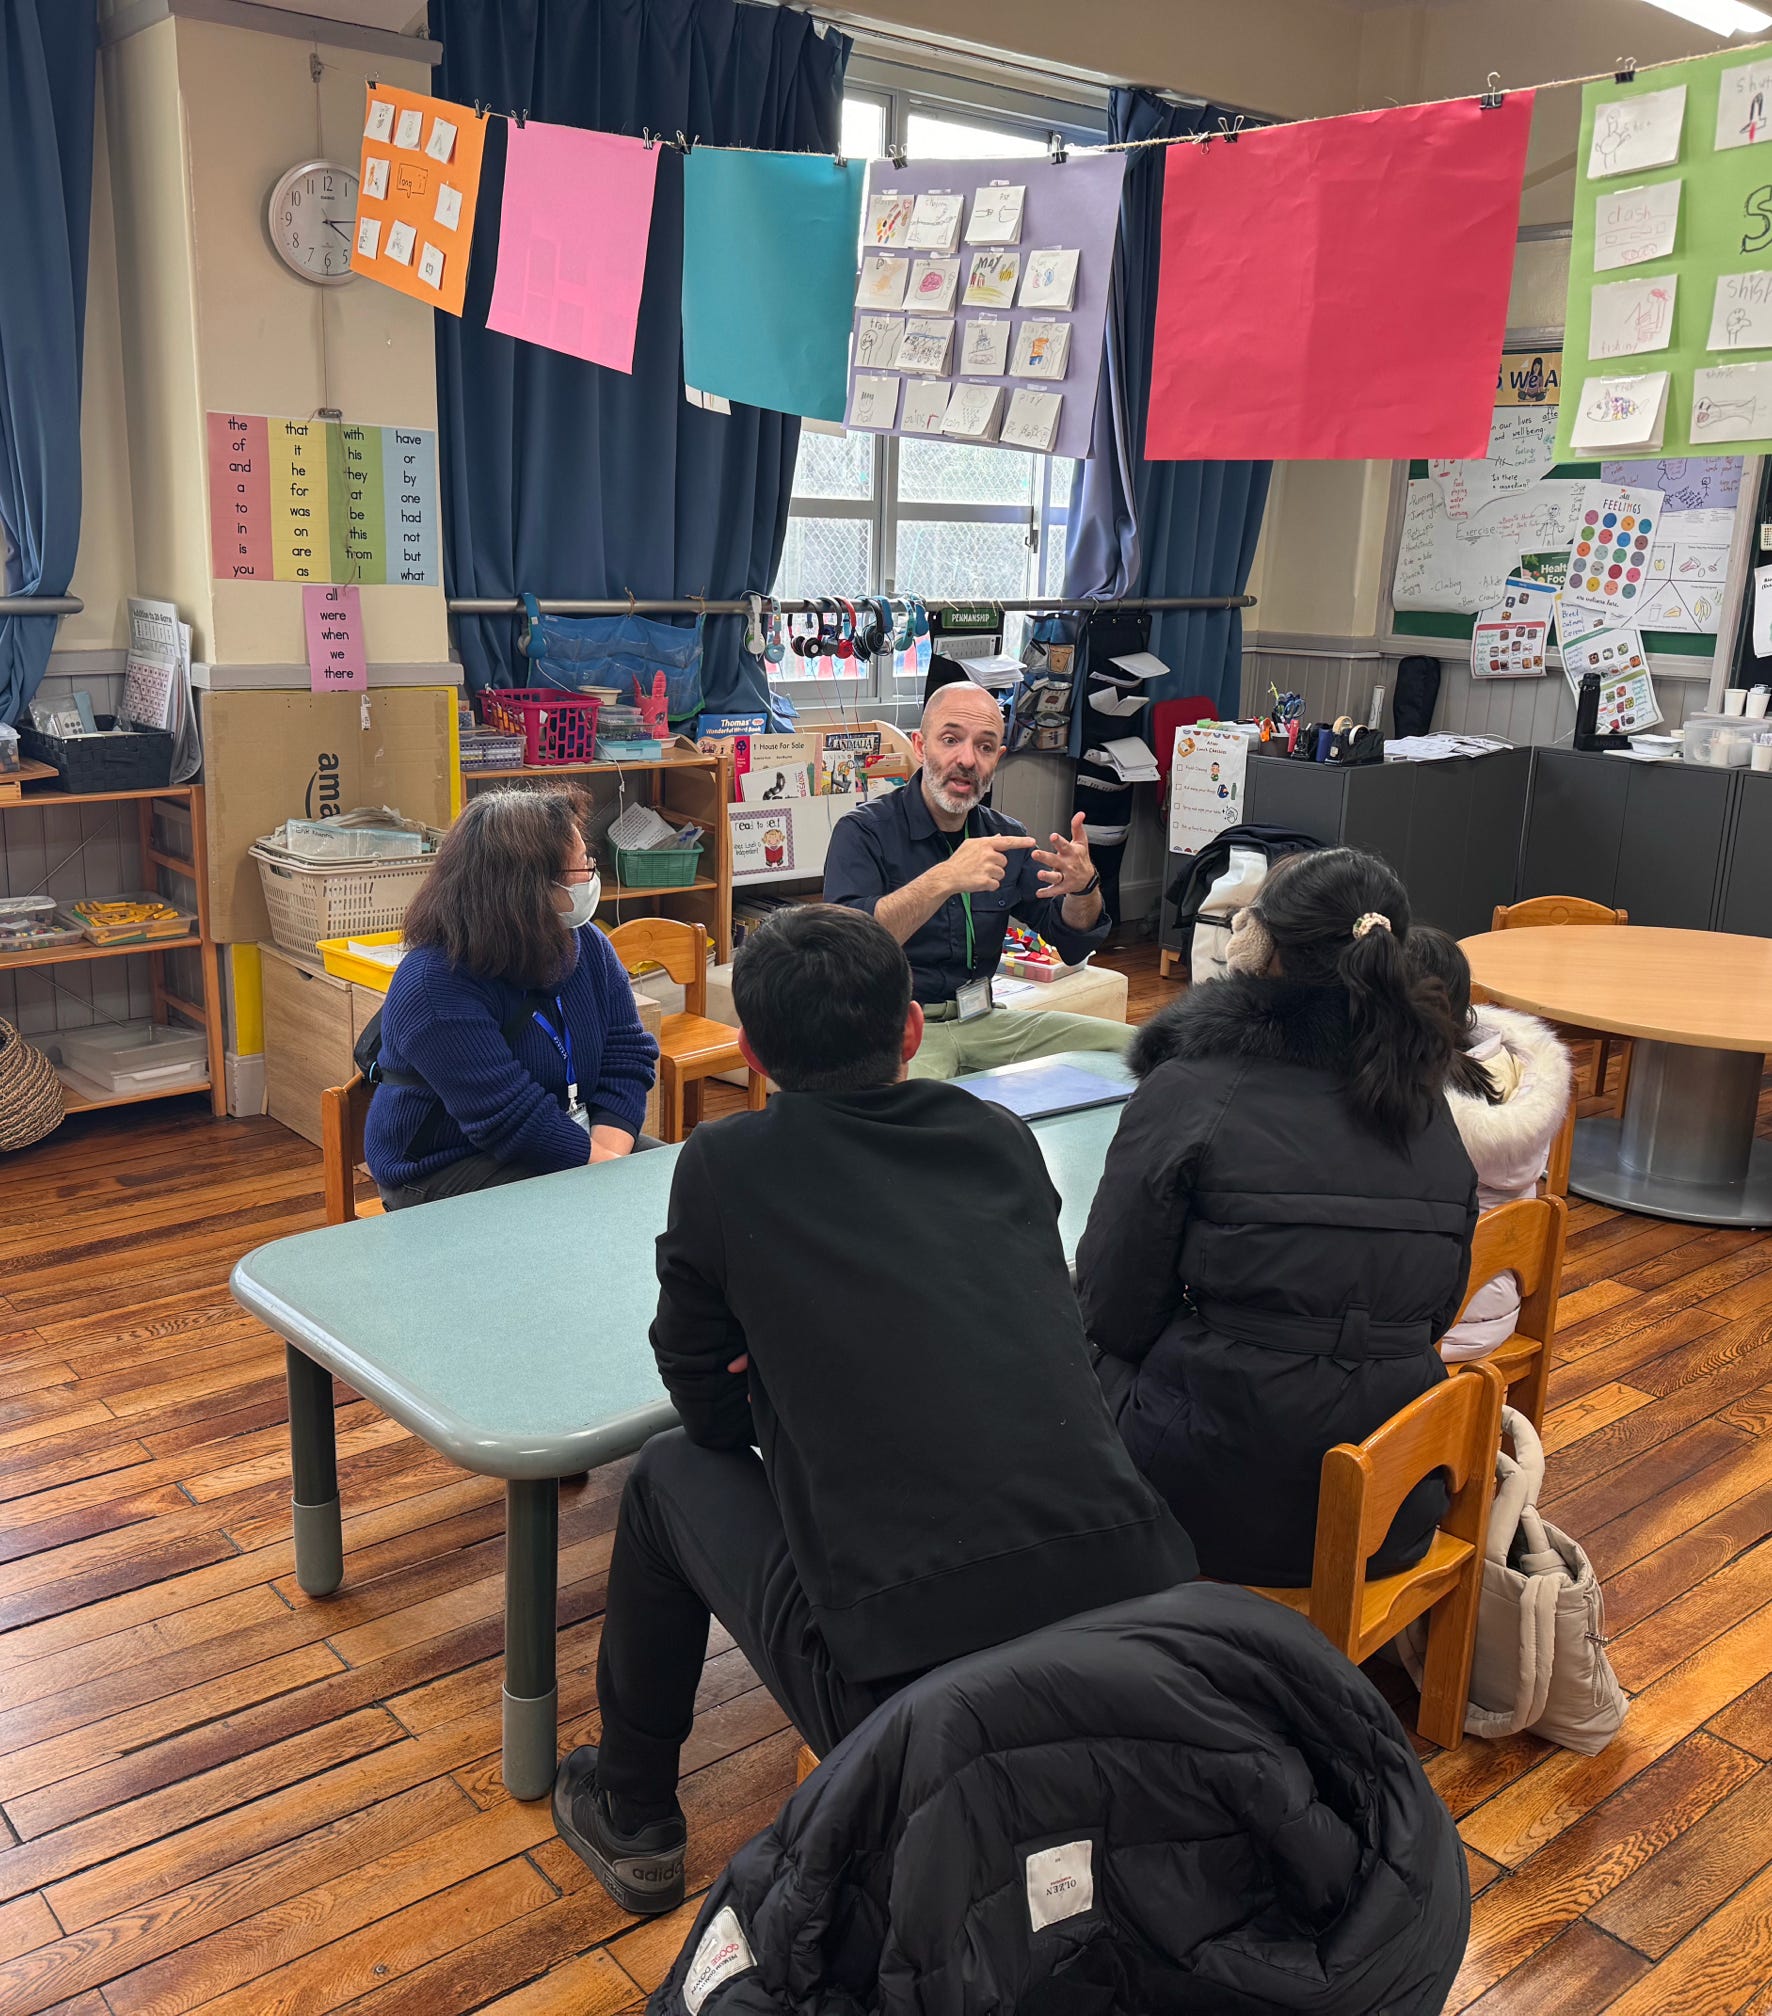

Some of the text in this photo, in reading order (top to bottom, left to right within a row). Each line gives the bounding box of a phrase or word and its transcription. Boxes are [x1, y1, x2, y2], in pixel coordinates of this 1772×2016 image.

[306, 178, 314, 195] 11
[323, 175, 333, 192] 12
[344, 181, 348, 198] 1
[291, 190, 301, 207] 10
[285, 211, 293, 227] 9
[292, 232, 300, 248] 8
[307, 247, 315, 262] 7
[324, 251, 331, 267] 6
[342, 248, 349, 265] 5
[1510, 371, 1538, 389] We
[228, 416, 248, 431] the
[285, 421, 309, 436] that
[1500, 422, 1512, 430] our
[343, 427, 365, 441] with
[395, 430, 422, 445] have
[1494, 432, 1505, 441] and
[232, 438, 247, 452] of
[294, 445, 302, 456] it
[348, 446, 362, 460] his
[403, 455, 416, 465] or
[229, 459, 251, 473] and
[291, 462, 306, 476] he
[344, 466, 368, 483] they
[403, 470, 417, 487] by
[237, 483, 245, 493] a
[290, 483, 309, 497] for
[350, 489, 363, 500] at
[400, 494, 421, 504] one
[235, 502, 248, 513] to
[289, 507, 311, 517] was
[350, 506, 365, 520] be
[1602, 499, 1642, 515] FEELINGS
[401, 509, 421, 523] had
[237, 523, 247, 534] in
[294, 527, 309, 537] on
[349, 526, 368, 540] this
[403, 531, 421, 542] not
[239, 544, 247, 554] is
[292, 547, 312, 557] are
[345, 546, 373, 560] from
[403, 548, 422, 562] but
[232, 565, 254, 577] you
[296, 567, 309, 577] as
[400, 568, 425, 581] what
[325, 587, 338, 601] all
[320, 612, 346, 621] were
[951, 613, 990, 623] PENMANSHIP
[321, 627, 350, 641] when
[330, 651, 345, 660] we
[323, 665, 354, 679] there
[1046, 1879, 1077, 1896] OLZEN
[691, 1943, 740, 1995] GOOSE DOWN
